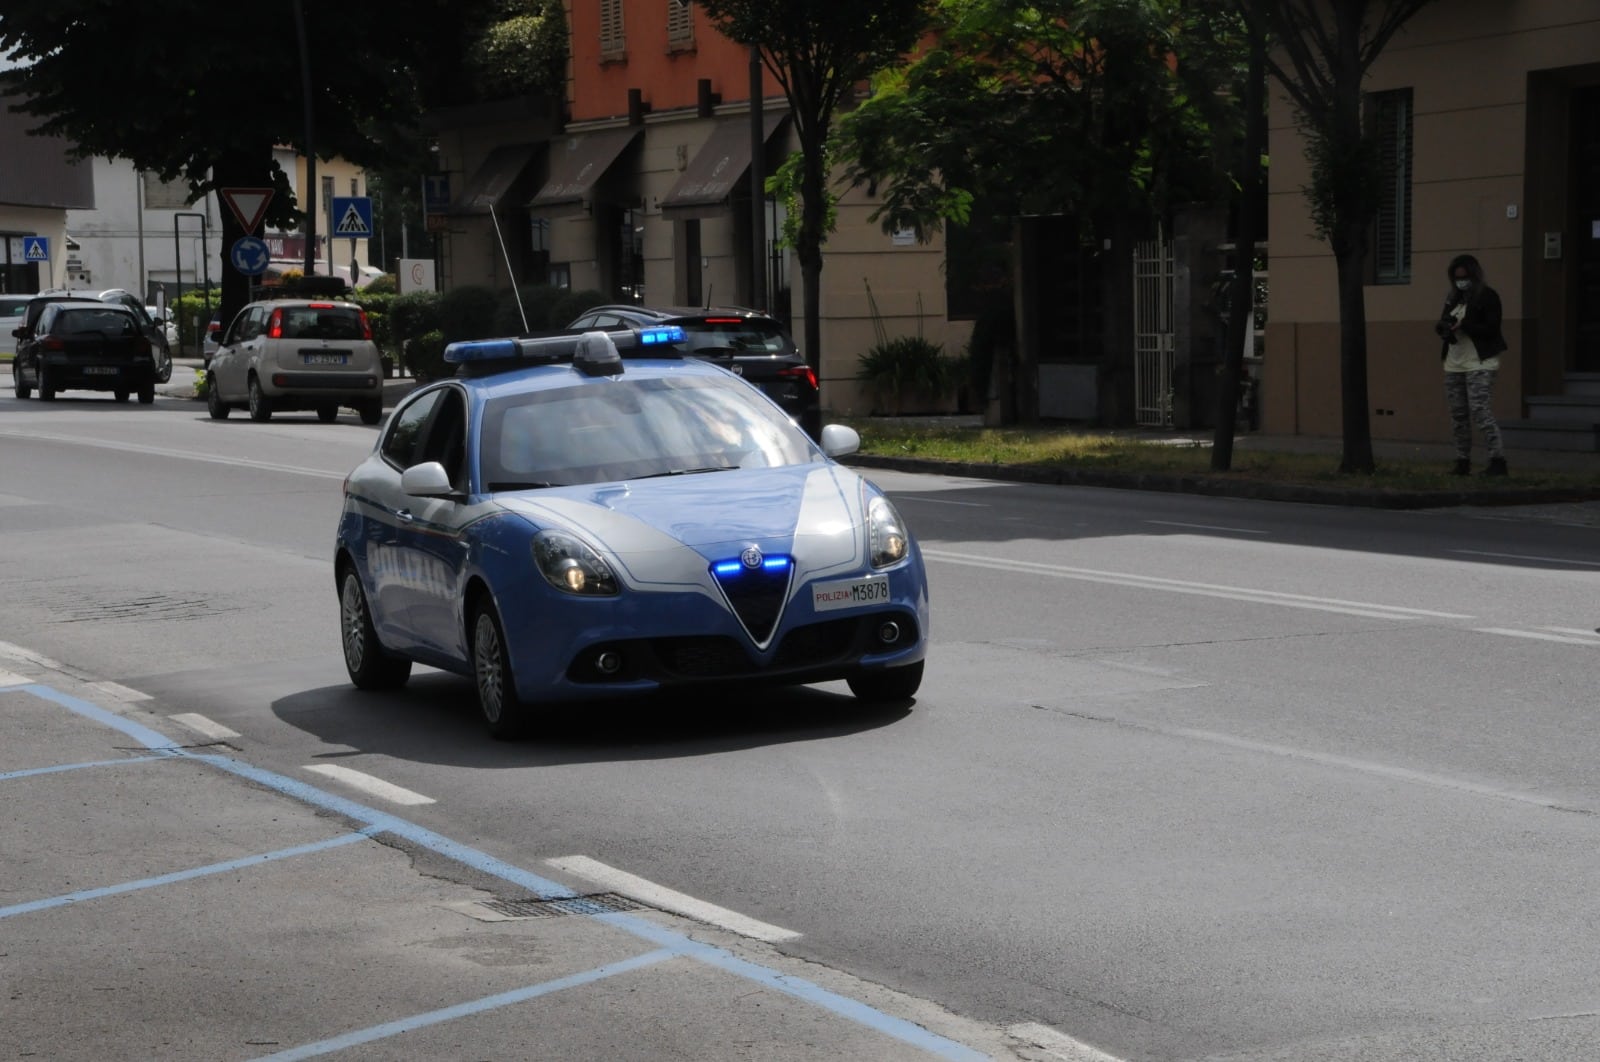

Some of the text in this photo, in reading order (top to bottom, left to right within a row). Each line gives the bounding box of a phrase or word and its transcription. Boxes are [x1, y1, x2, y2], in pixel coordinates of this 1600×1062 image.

[367, 540, 457, 600] POLIZIA
[816, 582, 888, 603] POLIZIA M3878
